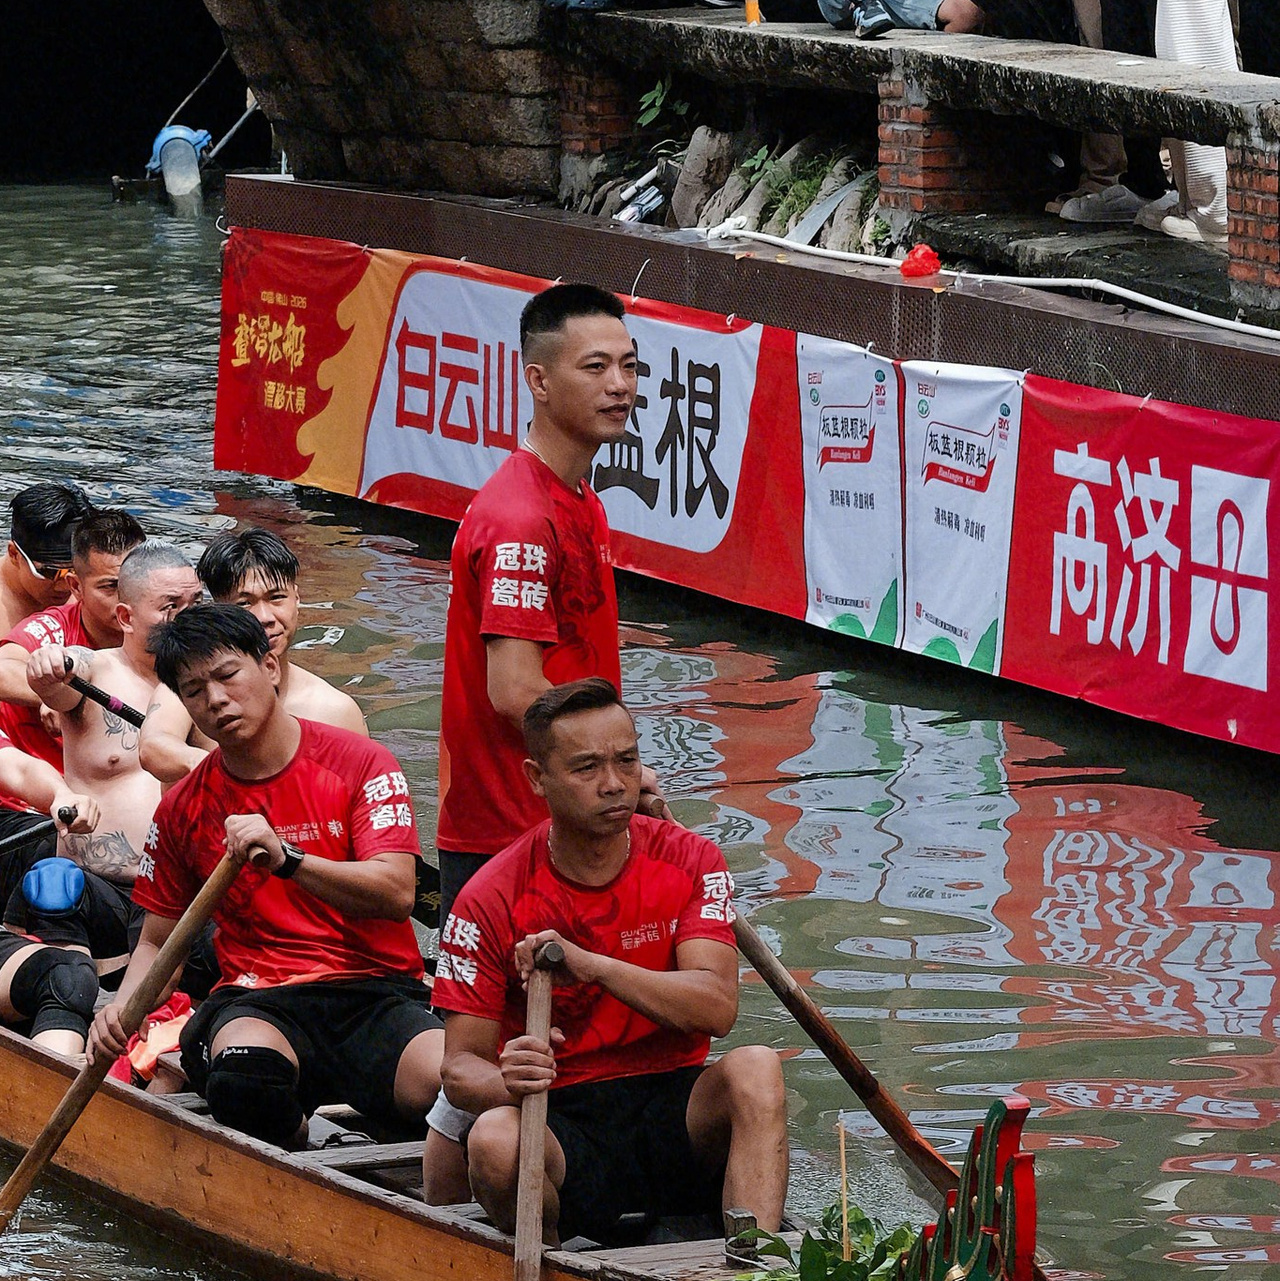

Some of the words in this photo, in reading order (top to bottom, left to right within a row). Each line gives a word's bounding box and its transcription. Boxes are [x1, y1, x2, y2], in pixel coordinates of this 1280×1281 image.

[395, 316, 519, 453] 白云山
[821, 414, 869, 440] 板蓝根颗粒
[928, 431, 987, 469] 板蓝根颗粒
[493, 542, 548, 576] 冠珠
[1049, 442, 1182, 665] 高济
[491, 577, 549, 612] 瓷砖
[362, 771, 410, 805] 冠珠
[369, 803, 412, 831] 瓷砖
[144, 820, 160, 851] 珠
[138, 848, 155, 883] 砖
